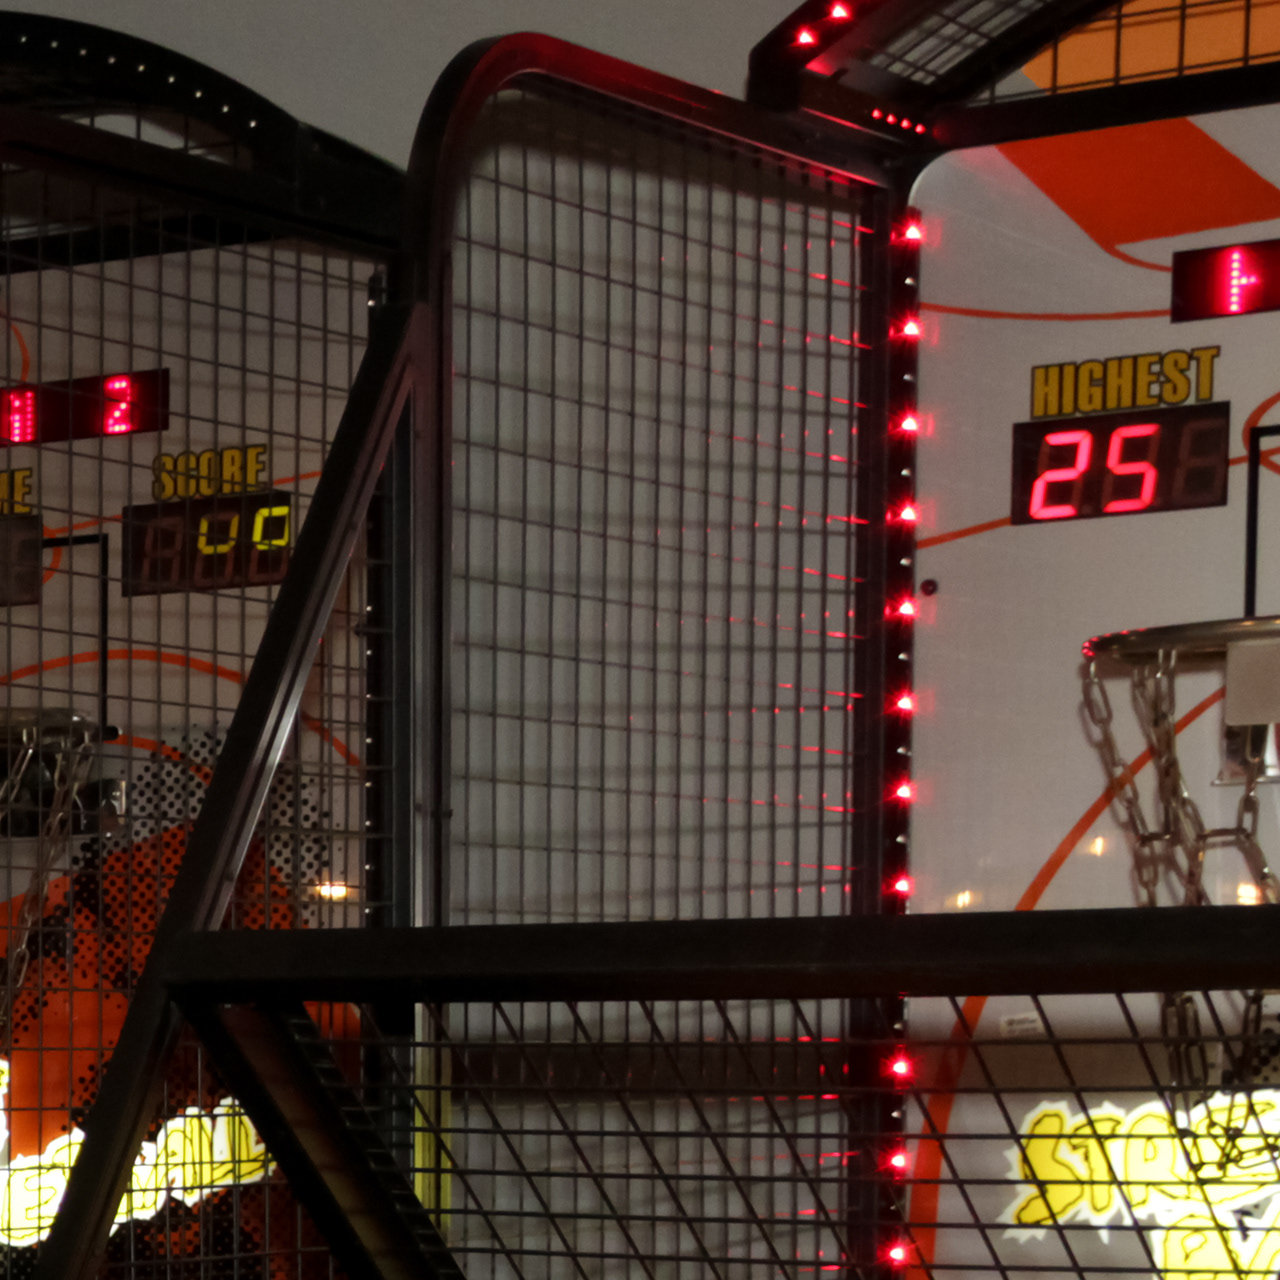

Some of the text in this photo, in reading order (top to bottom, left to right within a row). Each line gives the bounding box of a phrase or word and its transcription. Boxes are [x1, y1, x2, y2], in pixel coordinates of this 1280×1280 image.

[1030, 345, 1221, 420] HIGHEST
[152, 444, 267, 501] SCORE
[1029, 423, 1161, 520] 25
